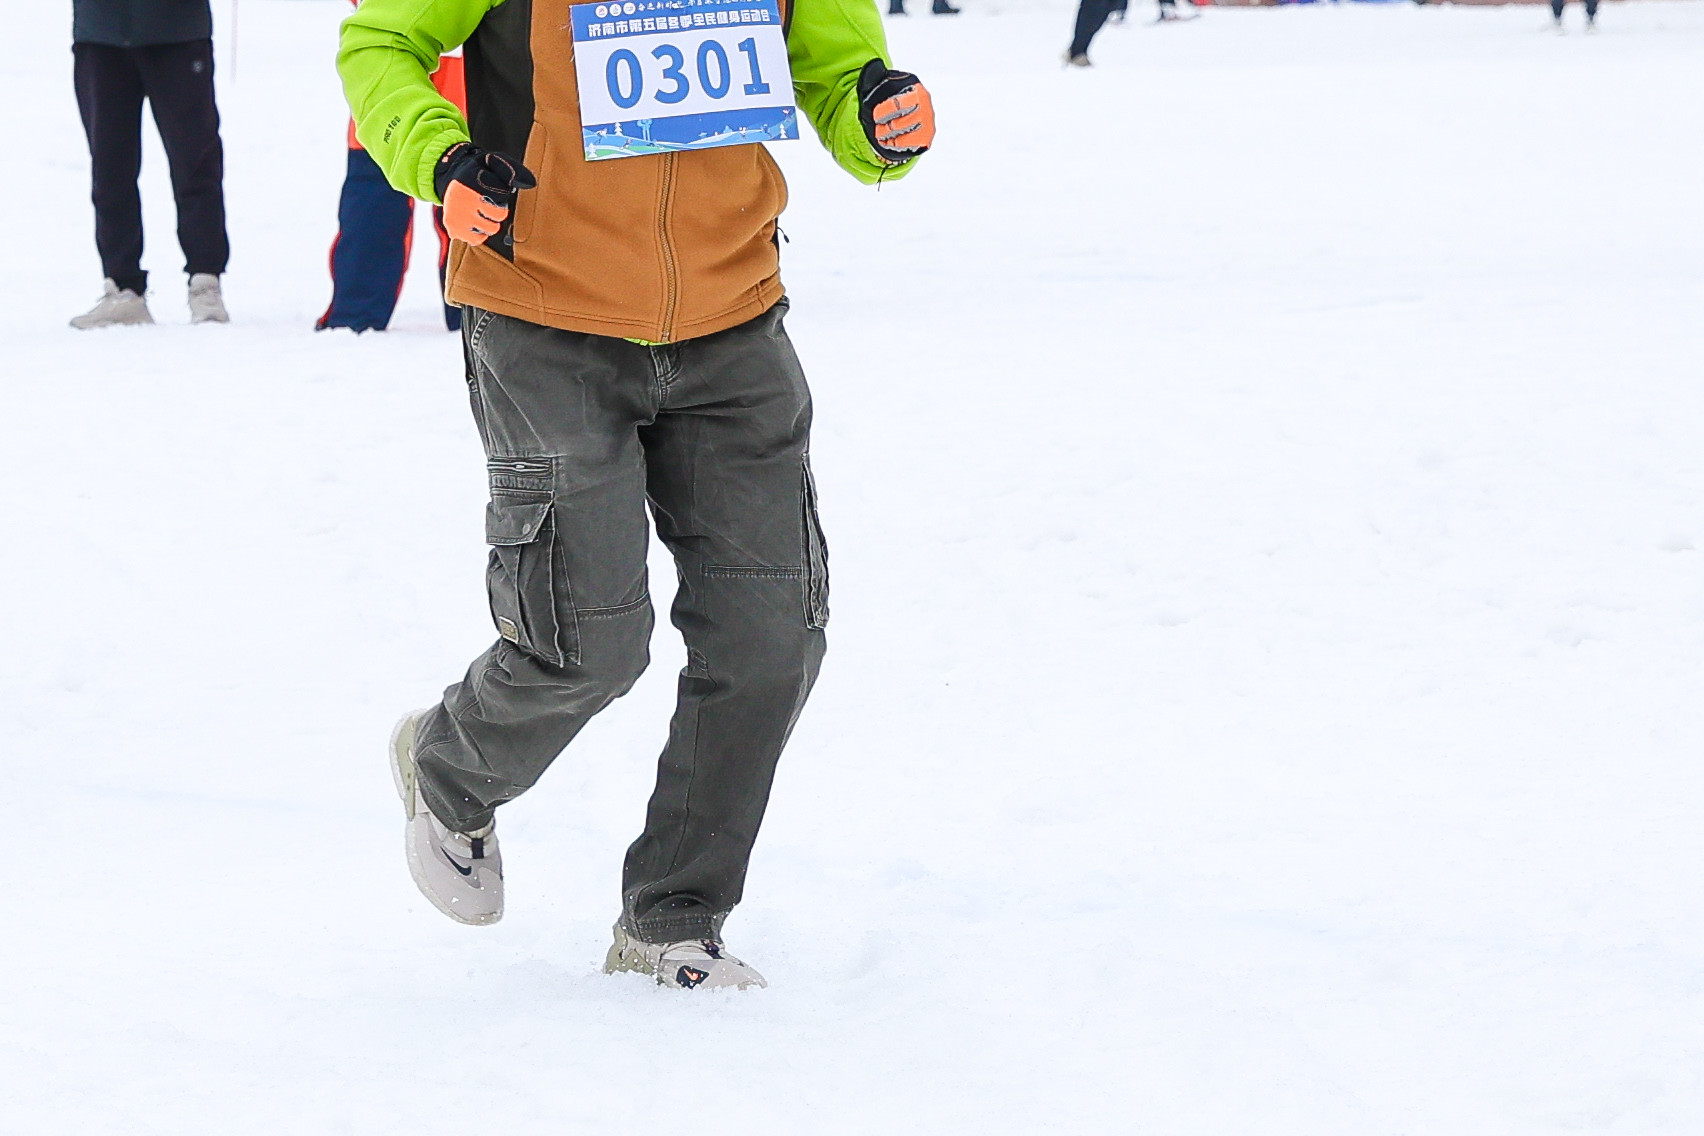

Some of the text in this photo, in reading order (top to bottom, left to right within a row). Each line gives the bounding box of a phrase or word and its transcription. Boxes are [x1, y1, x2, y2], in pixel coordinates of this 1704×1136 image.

[587, 8, 771, 38] 济南市第五届冬季全民健身运动会
[605, 37, 771, 110] 0301
